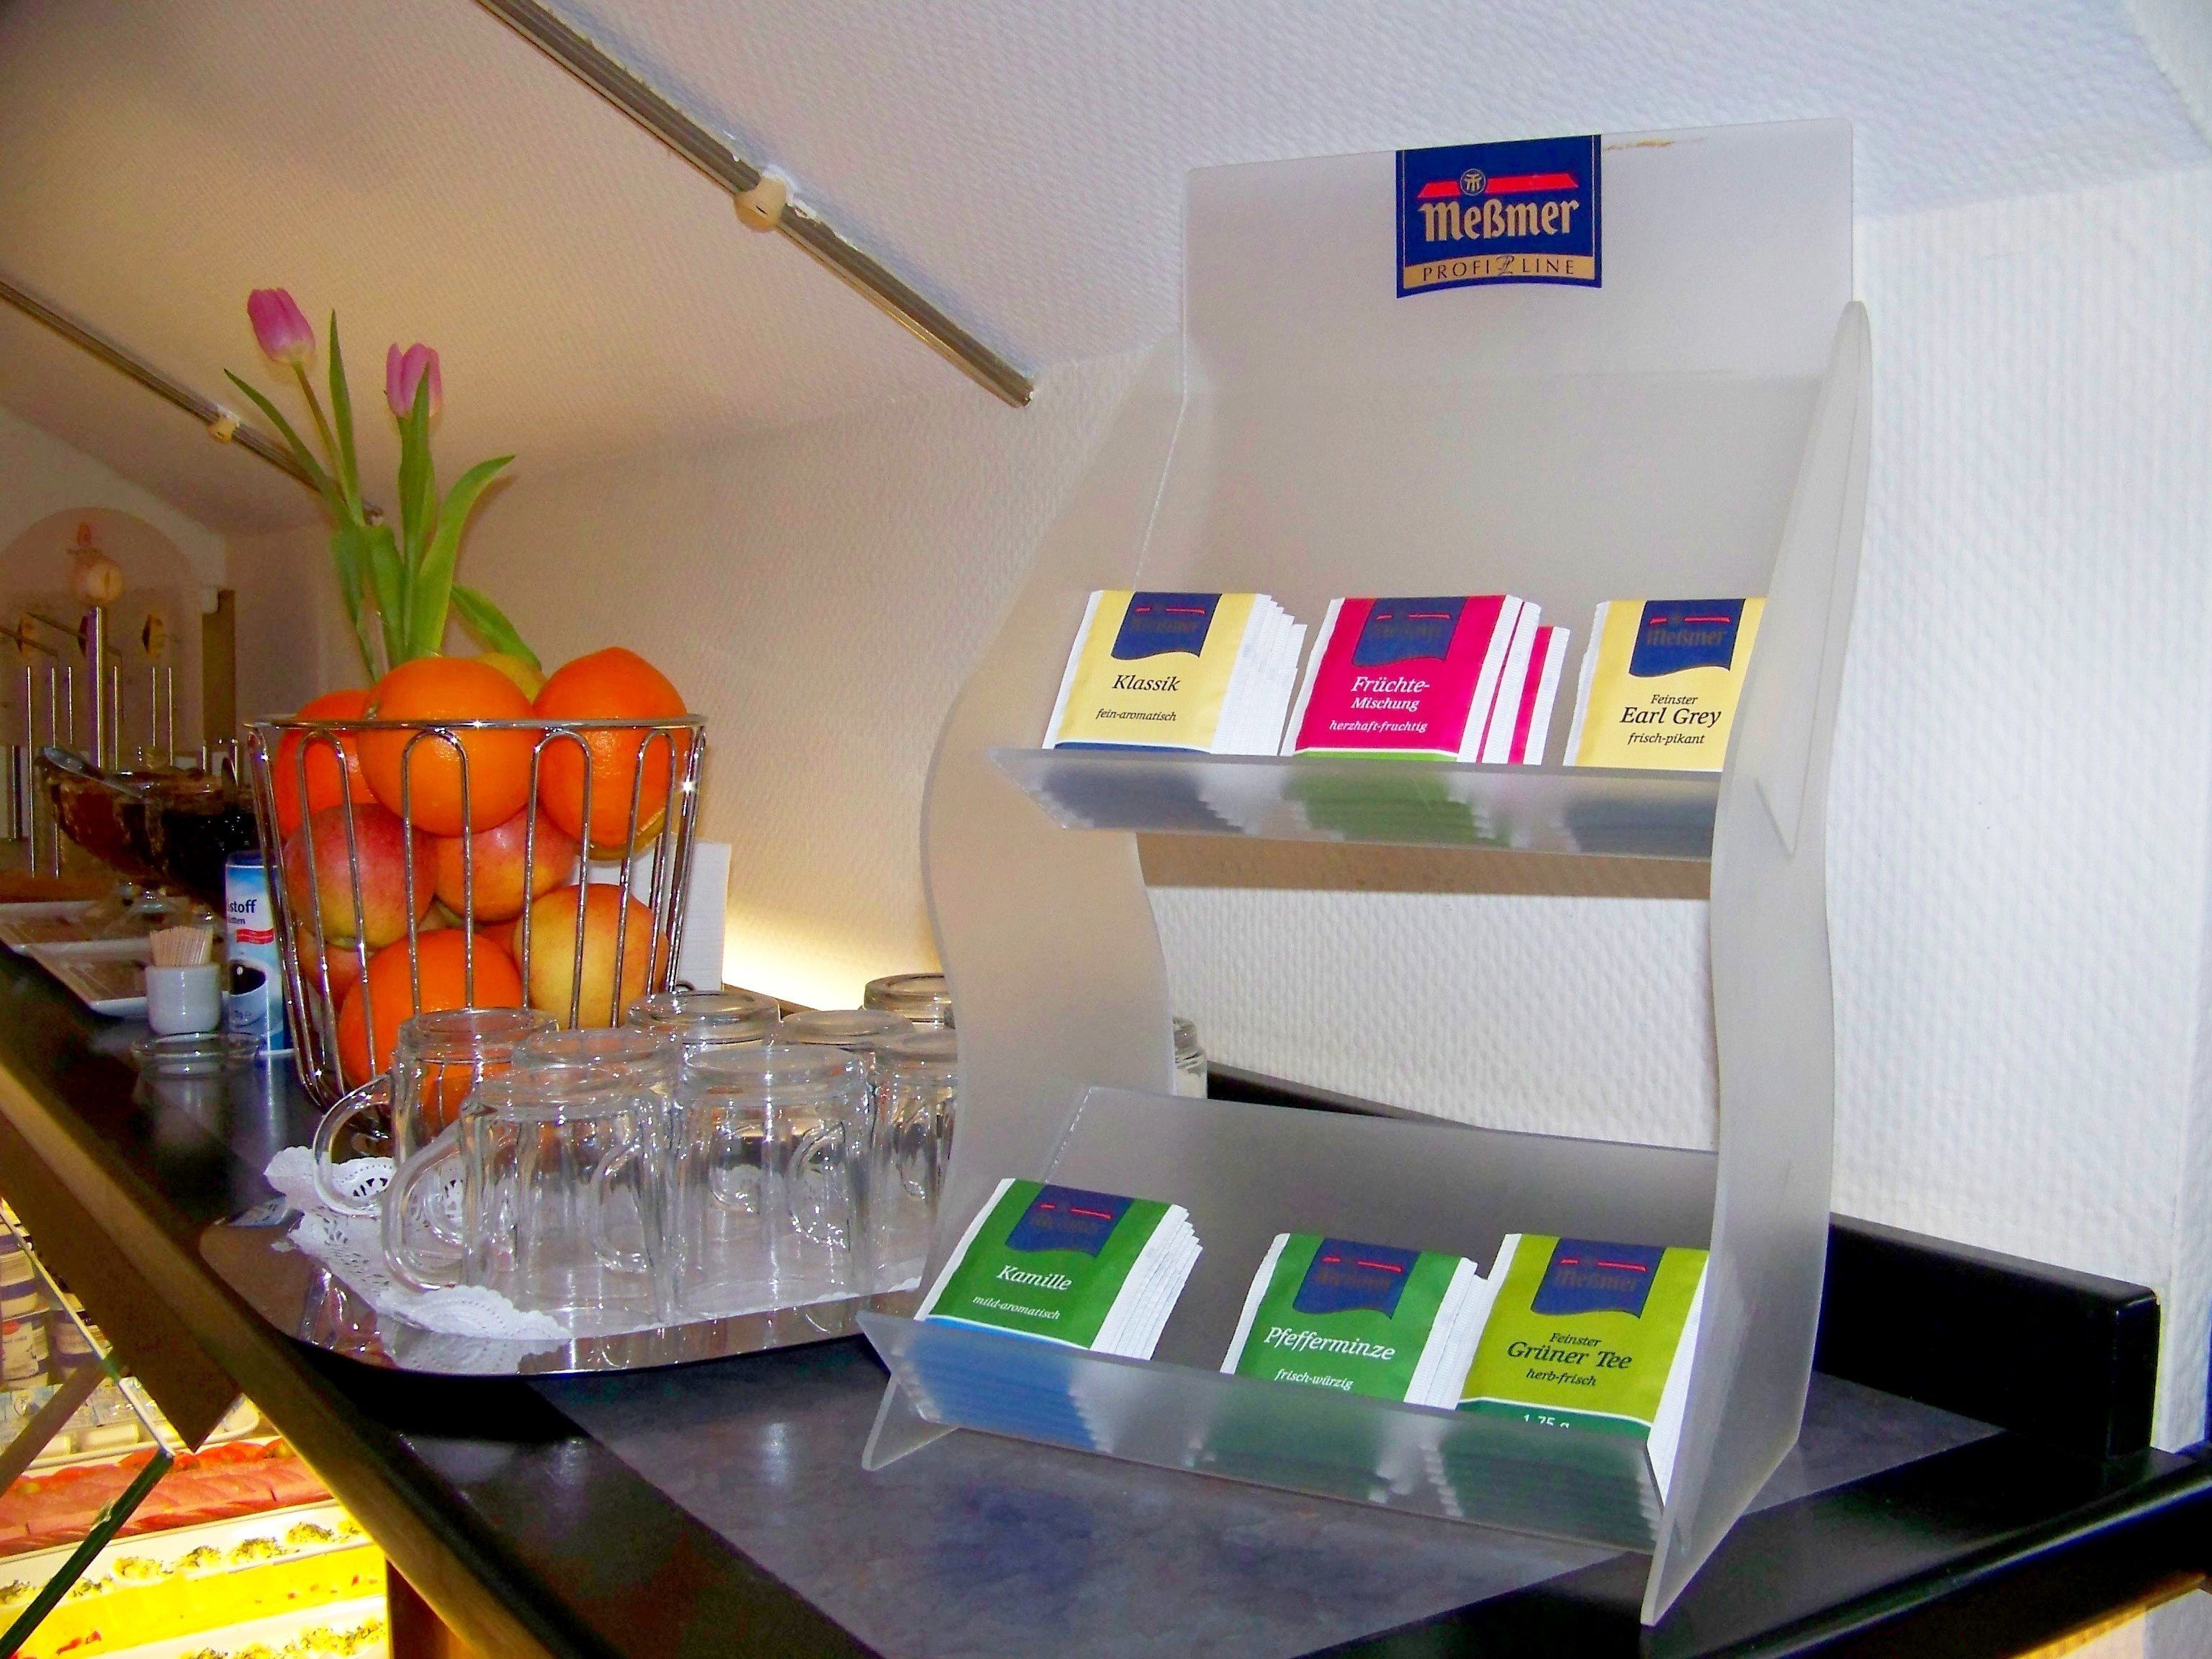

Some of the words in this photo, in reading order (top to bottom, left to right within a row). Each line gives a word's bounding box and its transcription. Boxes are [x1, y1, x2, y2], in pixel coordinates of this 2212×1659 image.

[1417, 198, 1580, 242] Meßmer
[1423, 258, 1491, 282] PROFI
[1521, 257, 1575, 274] LINE
[1111, 674, 1182, 692] Klassik
[1350, 675, 1431, 693] Früchte-
[1350, 697, 1419, 712] Mischung
[1650, 693, 1698, 706] Feinster
[1095, 708, 1177, 721] fein-aromatisch
[1619, 706, 1667, 724] Earl
[1673, 708, 1722, 728] Grey
[1329, 719, 1428, 734] herzhaft-fruchtig
[1627, 732, 1705, 746] frisch-pikant
[228, 899, 257, 914] stoff
[996, 1264, 1072, 1291] Kamille
[971, 1295, 1061, 1321] mild-aromatisch
[1263, 1326, 1396, 1361] Pfefferminze
[1549, 1332, 1602, 1348] Feinster
[1507, 1341, 1590, 1367] Grüner
[1596, 1350, 1633, 1370] Tee
[1274, 1368, 1354, 1391] frisch-würzig
[1525, 1368, 1597, 1386] herb-frisch
